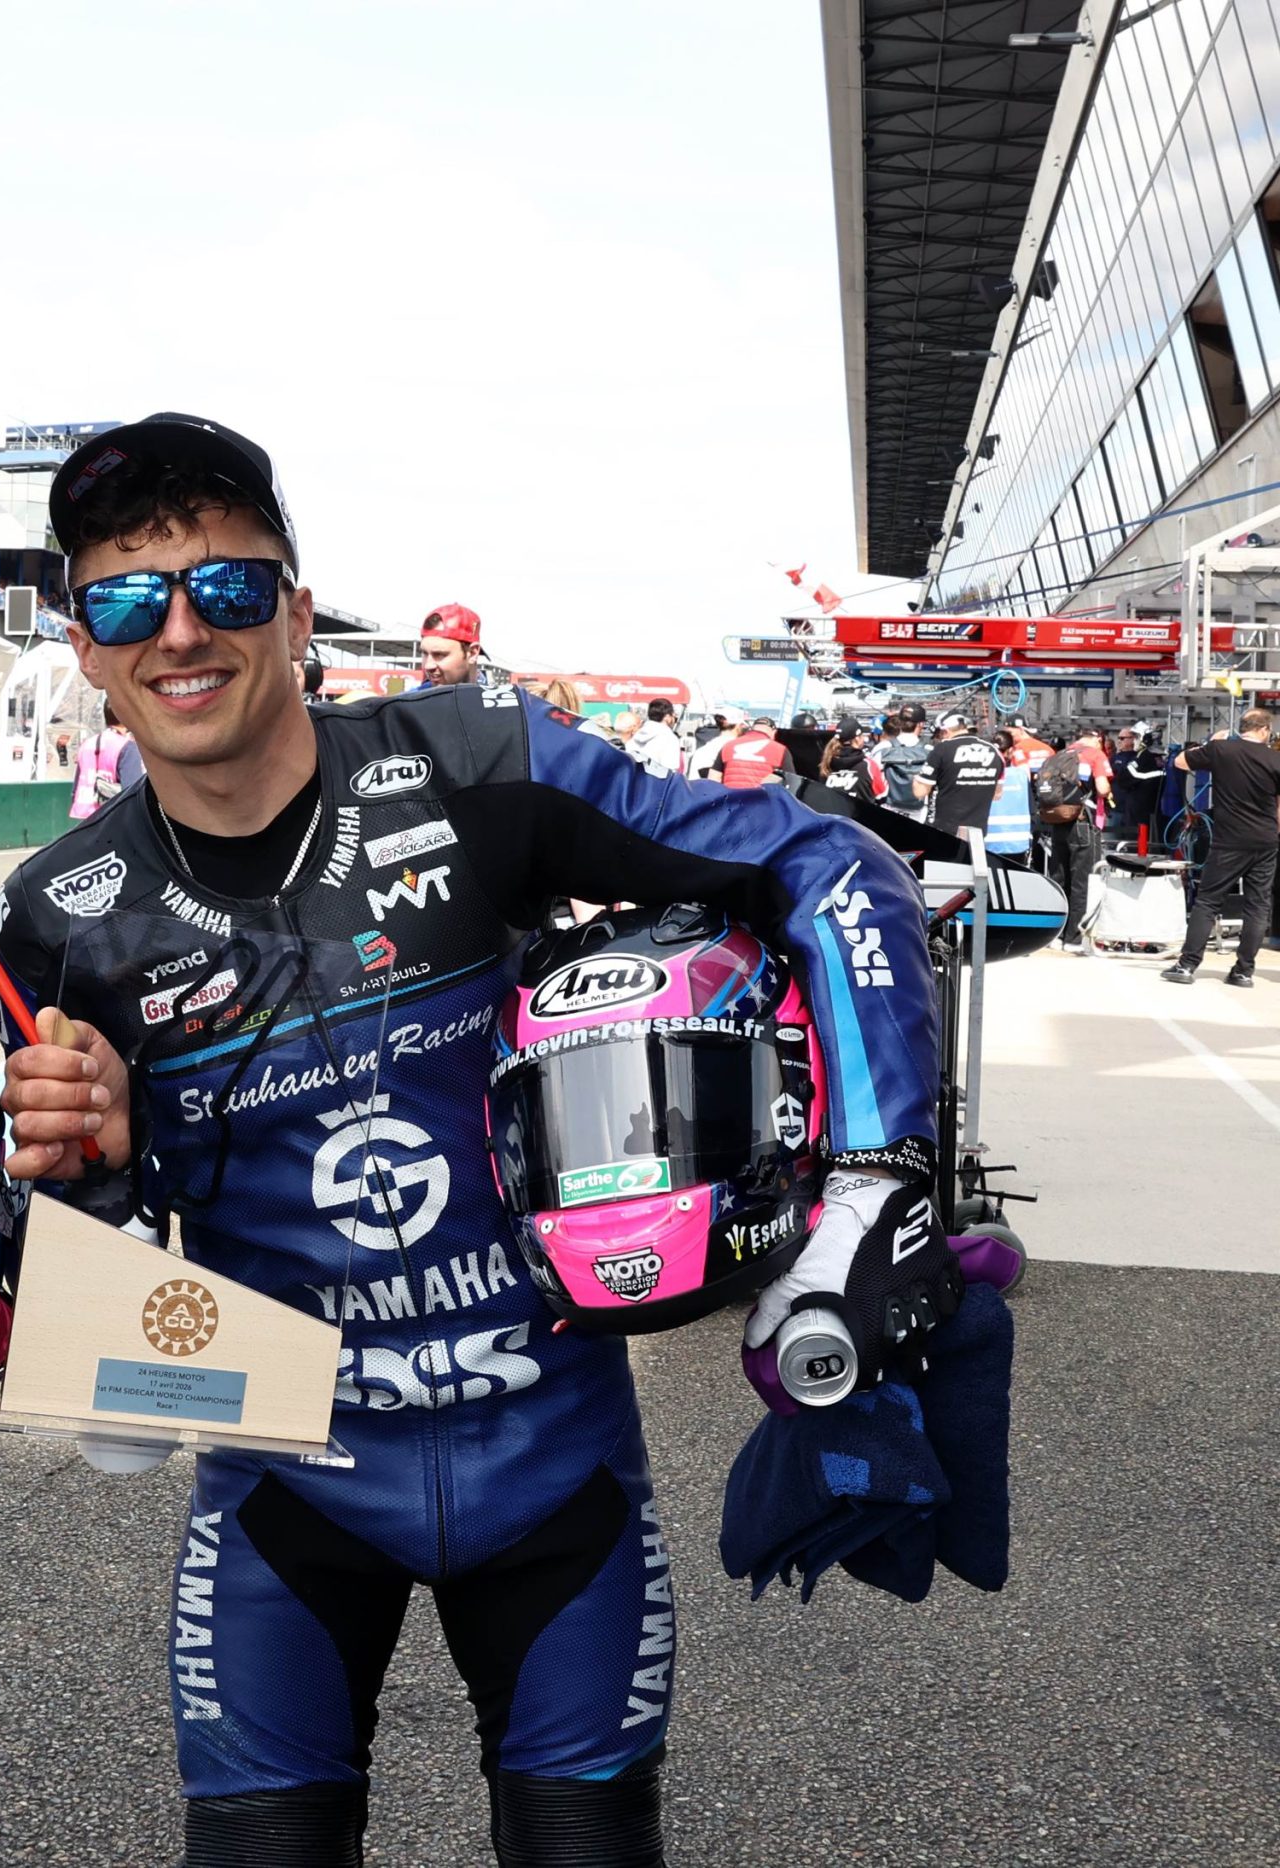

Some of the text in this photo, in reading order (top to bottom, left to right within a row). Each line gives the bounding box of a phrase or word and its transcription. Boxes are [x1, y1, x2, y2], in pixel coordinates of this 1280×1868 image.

[357, 757, 424, 793] Arai
[320, 805, 360, 888] YAMAHA
[393, 831, 453, 857] NOGARO
[53, 862, 123, 903] MOTO
[160, 881, 232, 938] YAMAHA
[144, 950, 209, 984] ytona
[536, 961, 649, 1014] Arai
[180, 1004, 494, 1123] Stinhausen Racing
[490, 1016, 765, 1088] www.kevin-rousseau.fr
[563, 1172, 613, 1192] Sarthe
[304, 1242, 517, 1321] YAMAHA
[593, 1254, 662, 1282] MOTO
[138, 1368, 205, 1382] 24 HEURES MOTOS
[159, 1381, 173, 1389] avril
[176, 1383, 192, 1391] 2026
[124, 1387, 154, 1397] SIDECAR
[156, 1391, 183, 1400] WORLD
[185, 1394, 241, 1406] CHAMPIONSHIP
[175, 1511, 222, 1722] YAMAHA
[620, 1499, 673, 1730] YAMAHA
